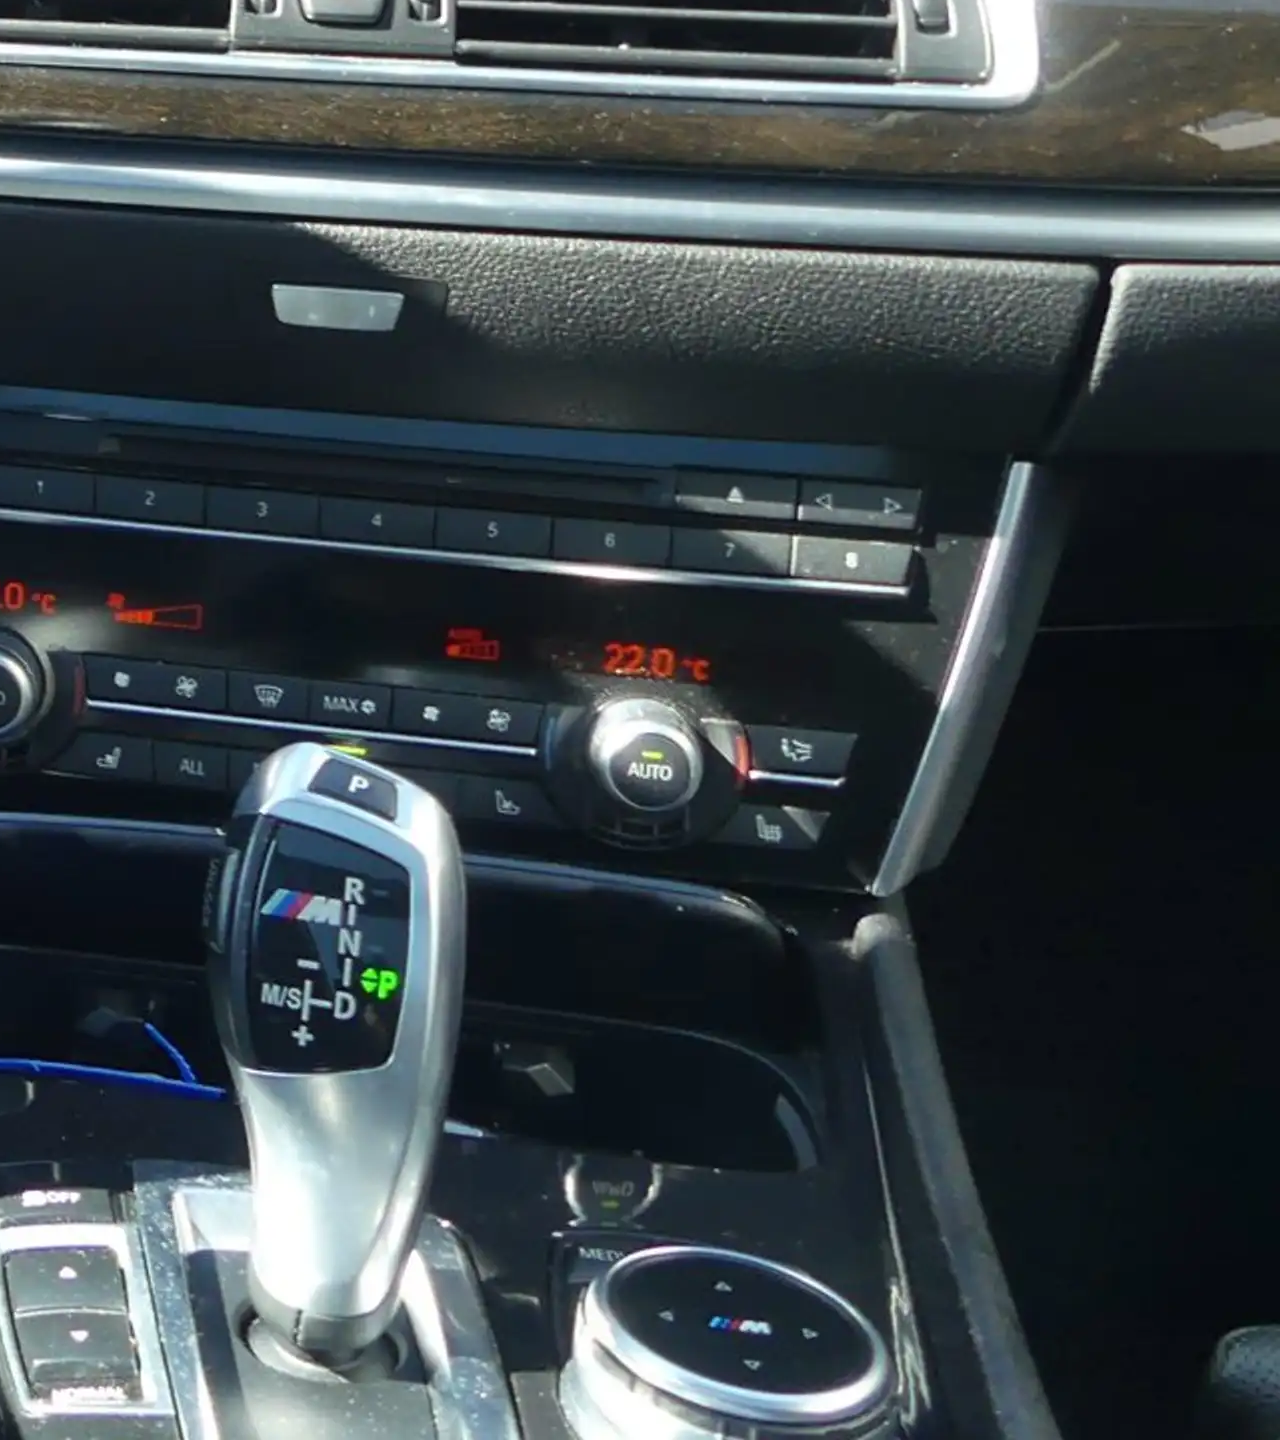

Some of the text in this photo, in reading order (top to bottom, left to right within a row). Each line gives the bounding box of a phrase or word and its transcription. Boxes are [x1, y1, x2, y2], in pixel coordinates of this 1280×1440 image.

[144, 491, 155, 506] 2
[257, 501, 269, 517] 3
[371, 513, 382, 528] 4
[488, 521, 499, 538] 5
[724, 543, 735, 557] 7
[604, 643, 675, 678] 22.0
[323, 695, 359, 713] MAX
[180, 758, 204, 775] ALL
[627, 762, 673, 781] AUTO
[348, 775, 369, 793] P
[344, 877, 365, 905] R
[339, 929, 362, 957] N
[378, 971, 399, 998] P
[261, 983, 301, 1010] M/S
[333, 992, 357, 1020] D
